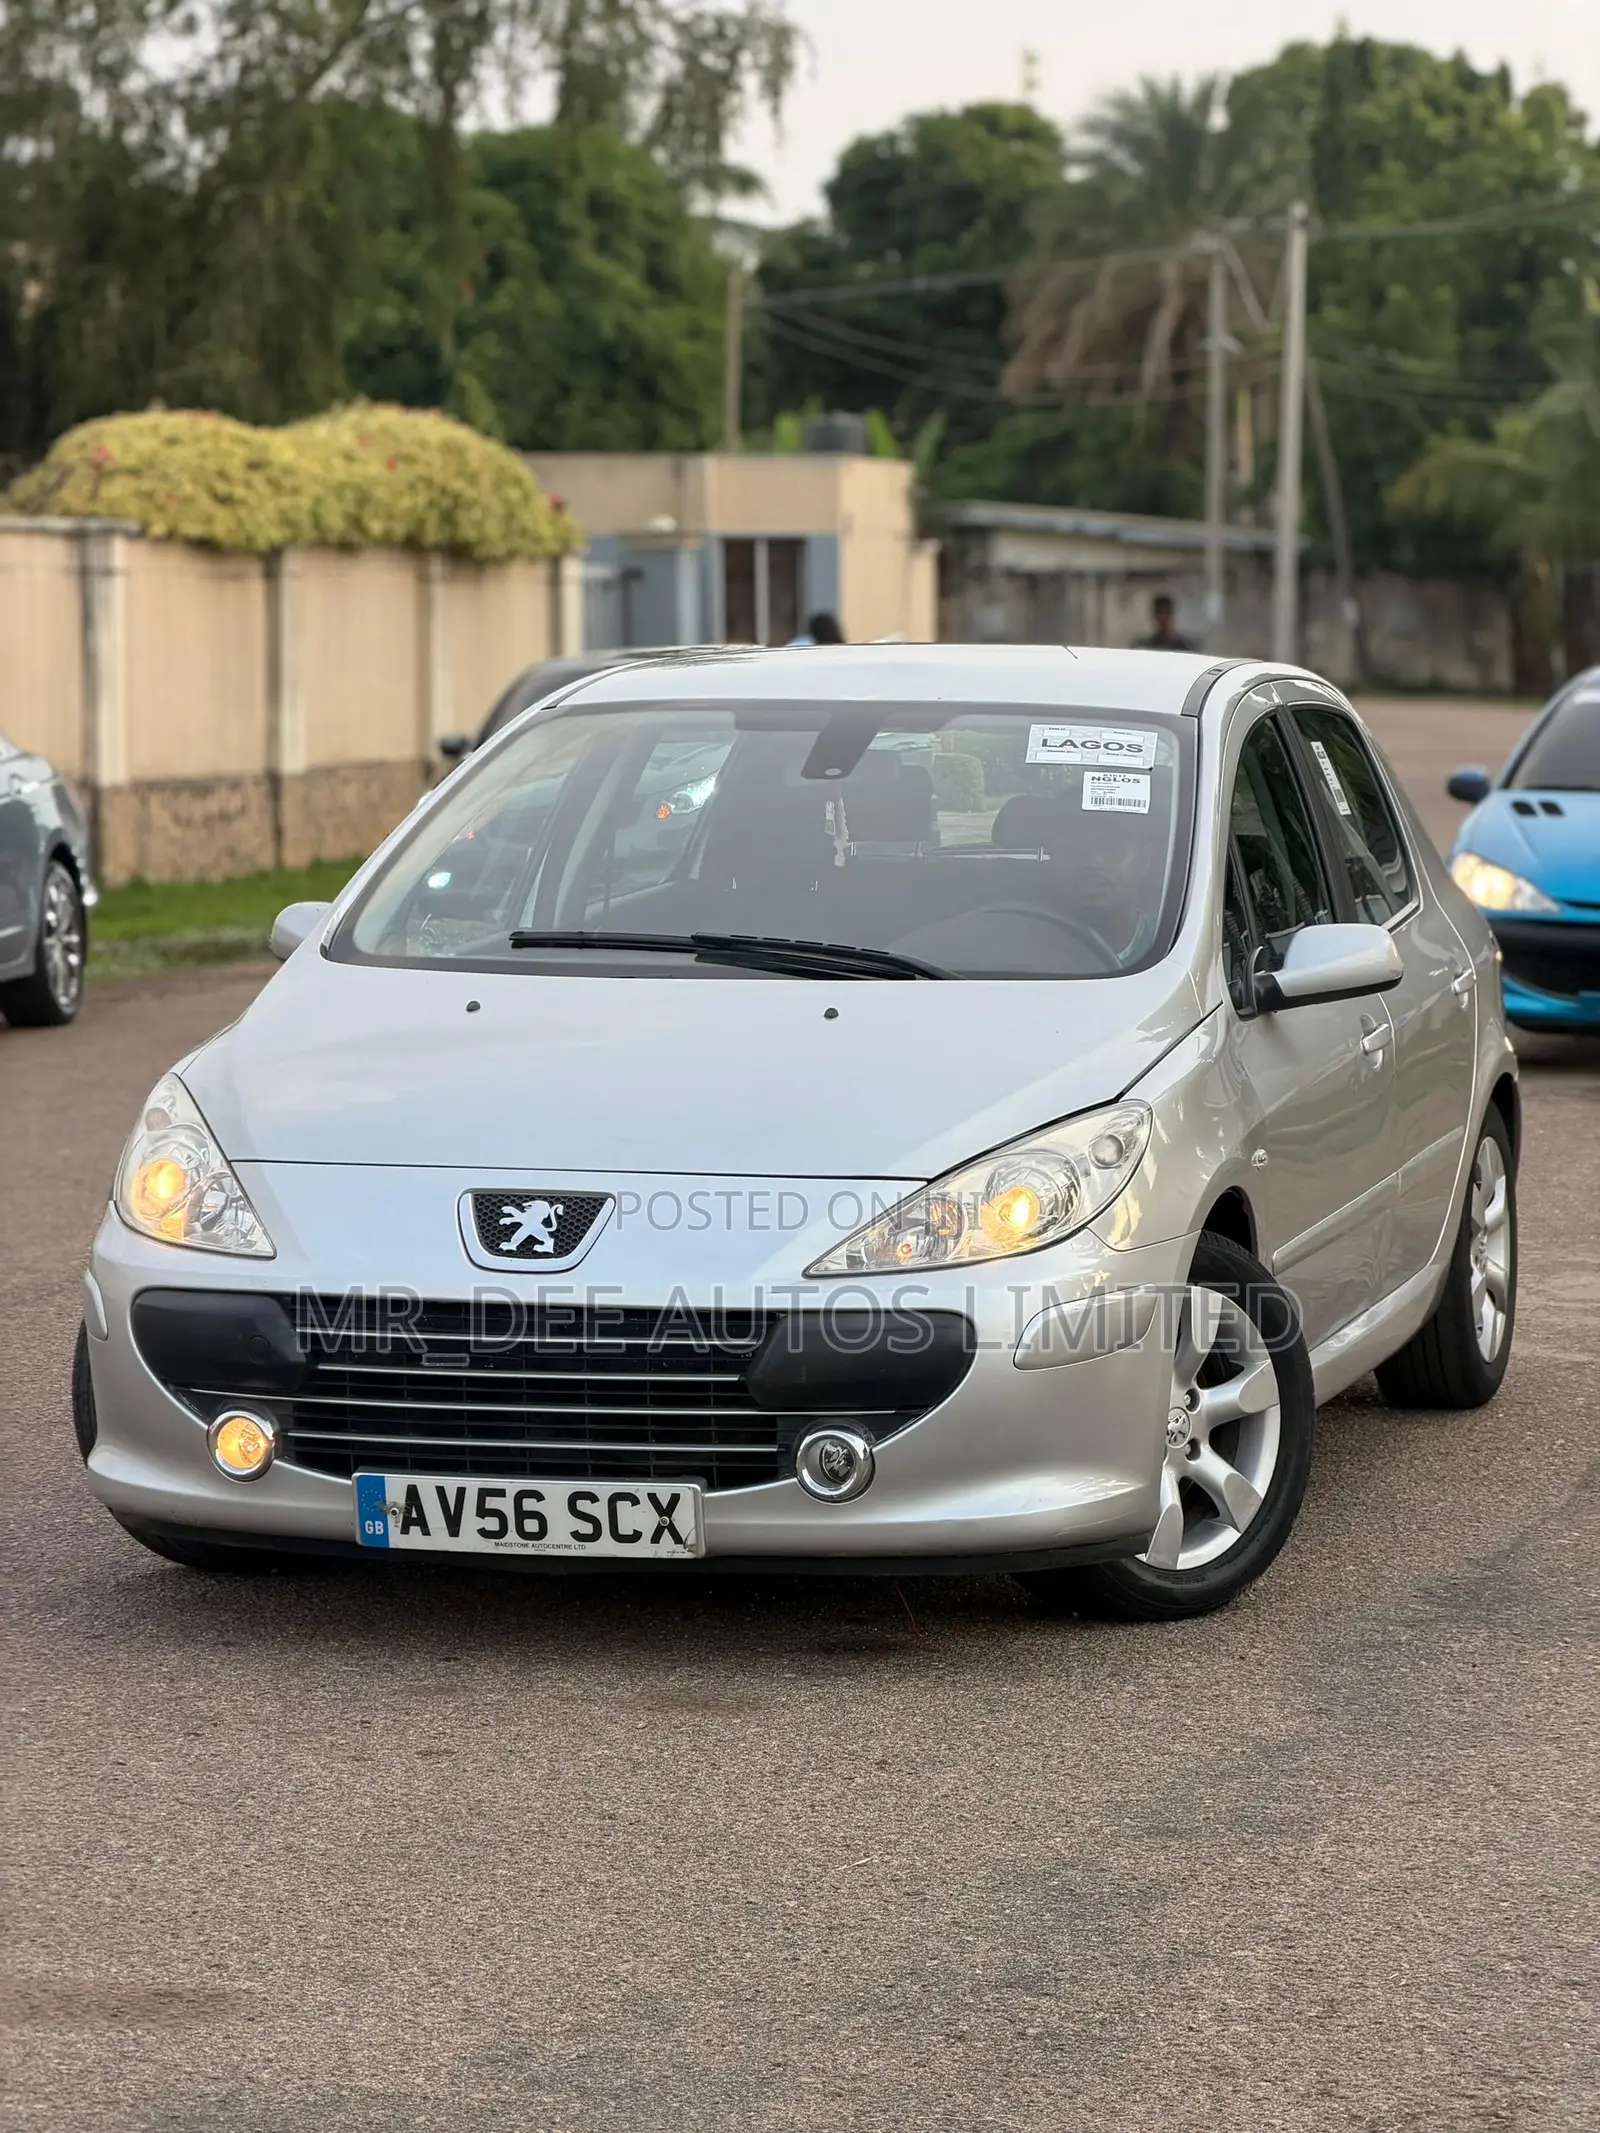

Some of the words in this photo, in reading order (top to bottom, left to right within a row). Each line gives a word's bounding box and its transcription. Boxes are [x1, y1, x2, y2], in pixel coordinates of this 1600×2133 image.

[1041, 738, 1143, 753] LAGOS
[400, 1483, 548, 1542] AV56
[567, 1490, 684, 1545] SCX
[364, 1519, 385, 1536] GB
